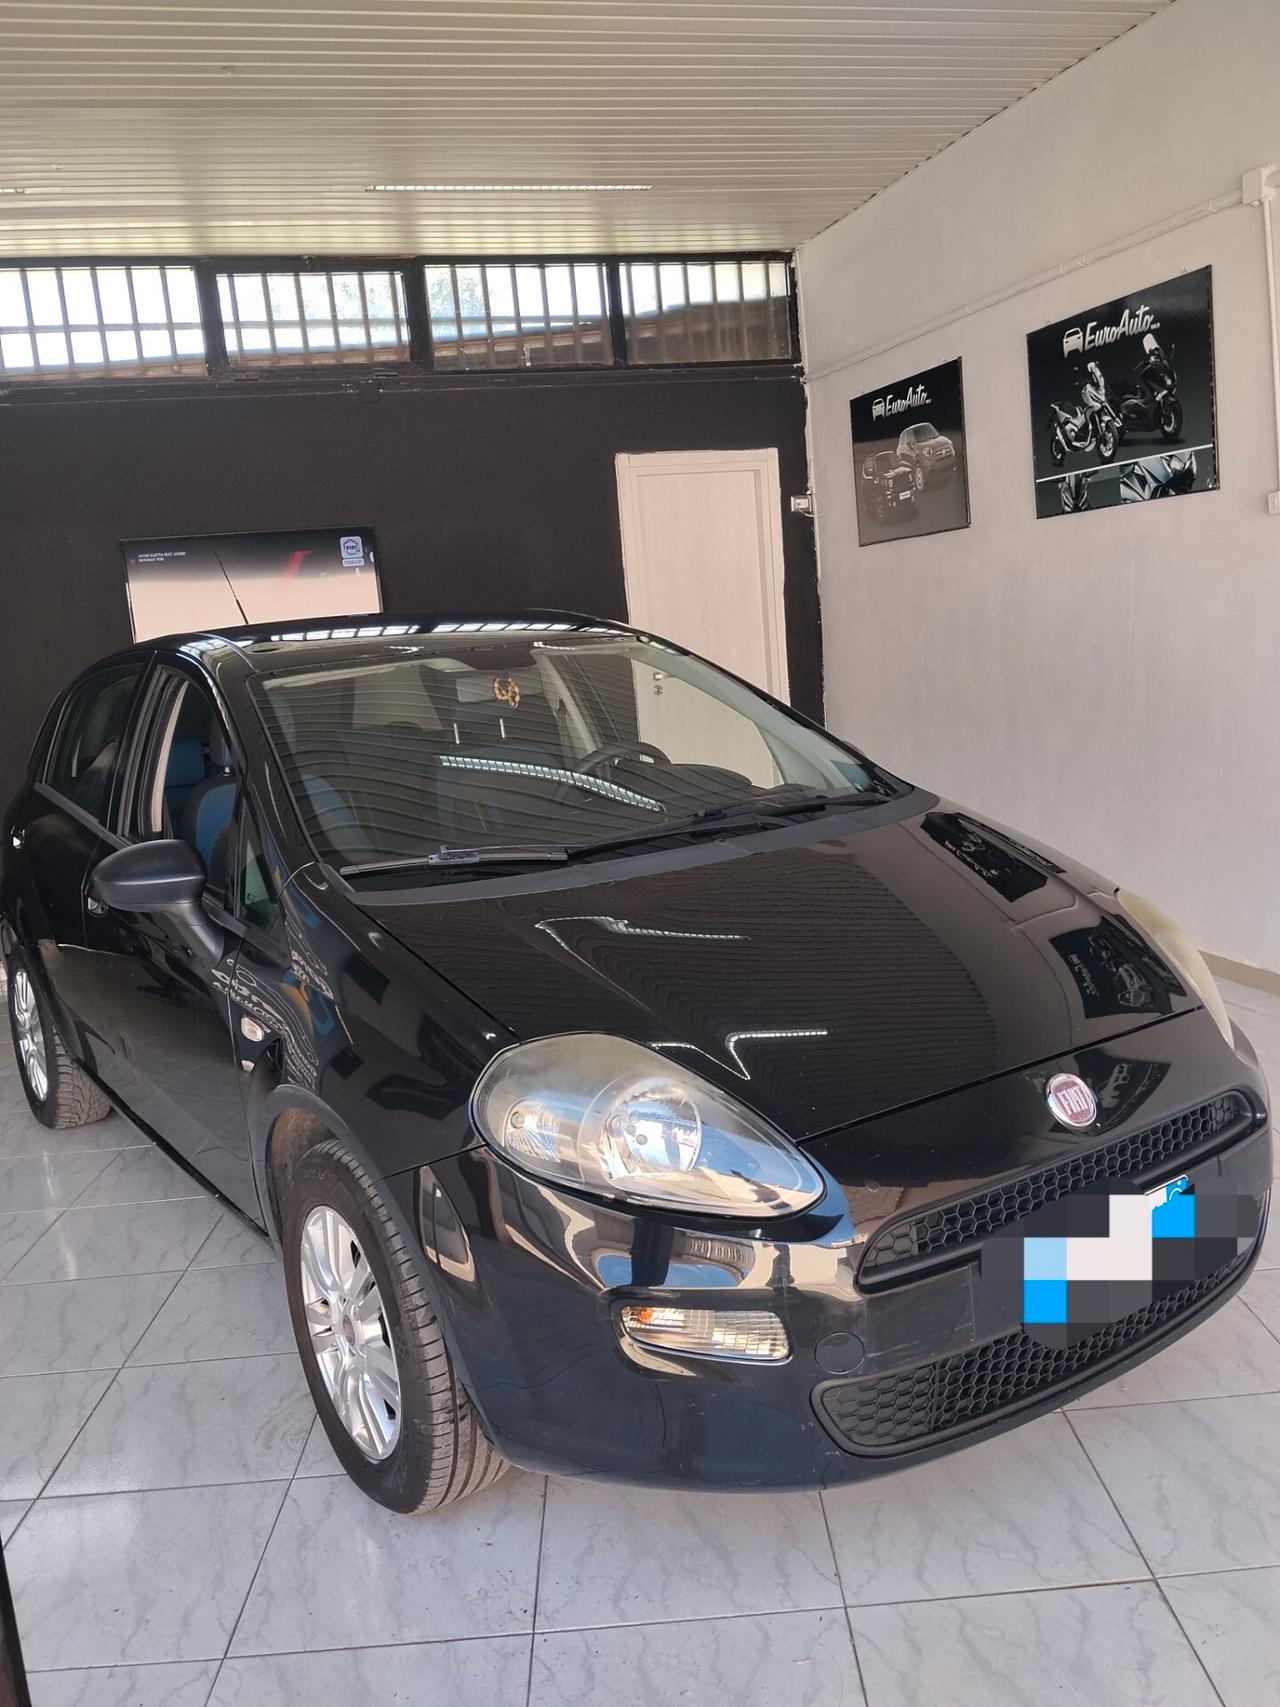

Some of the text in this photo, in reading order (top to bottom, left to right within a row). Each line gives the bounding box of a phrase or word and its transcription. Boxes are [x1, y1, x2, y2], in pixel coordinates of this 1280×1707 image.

[1084, 304, 1154, 351] EuroAuto
[886, 383, 928, 417] EuroAuto
[1056, 1085, 1088, 1116] FIAT
